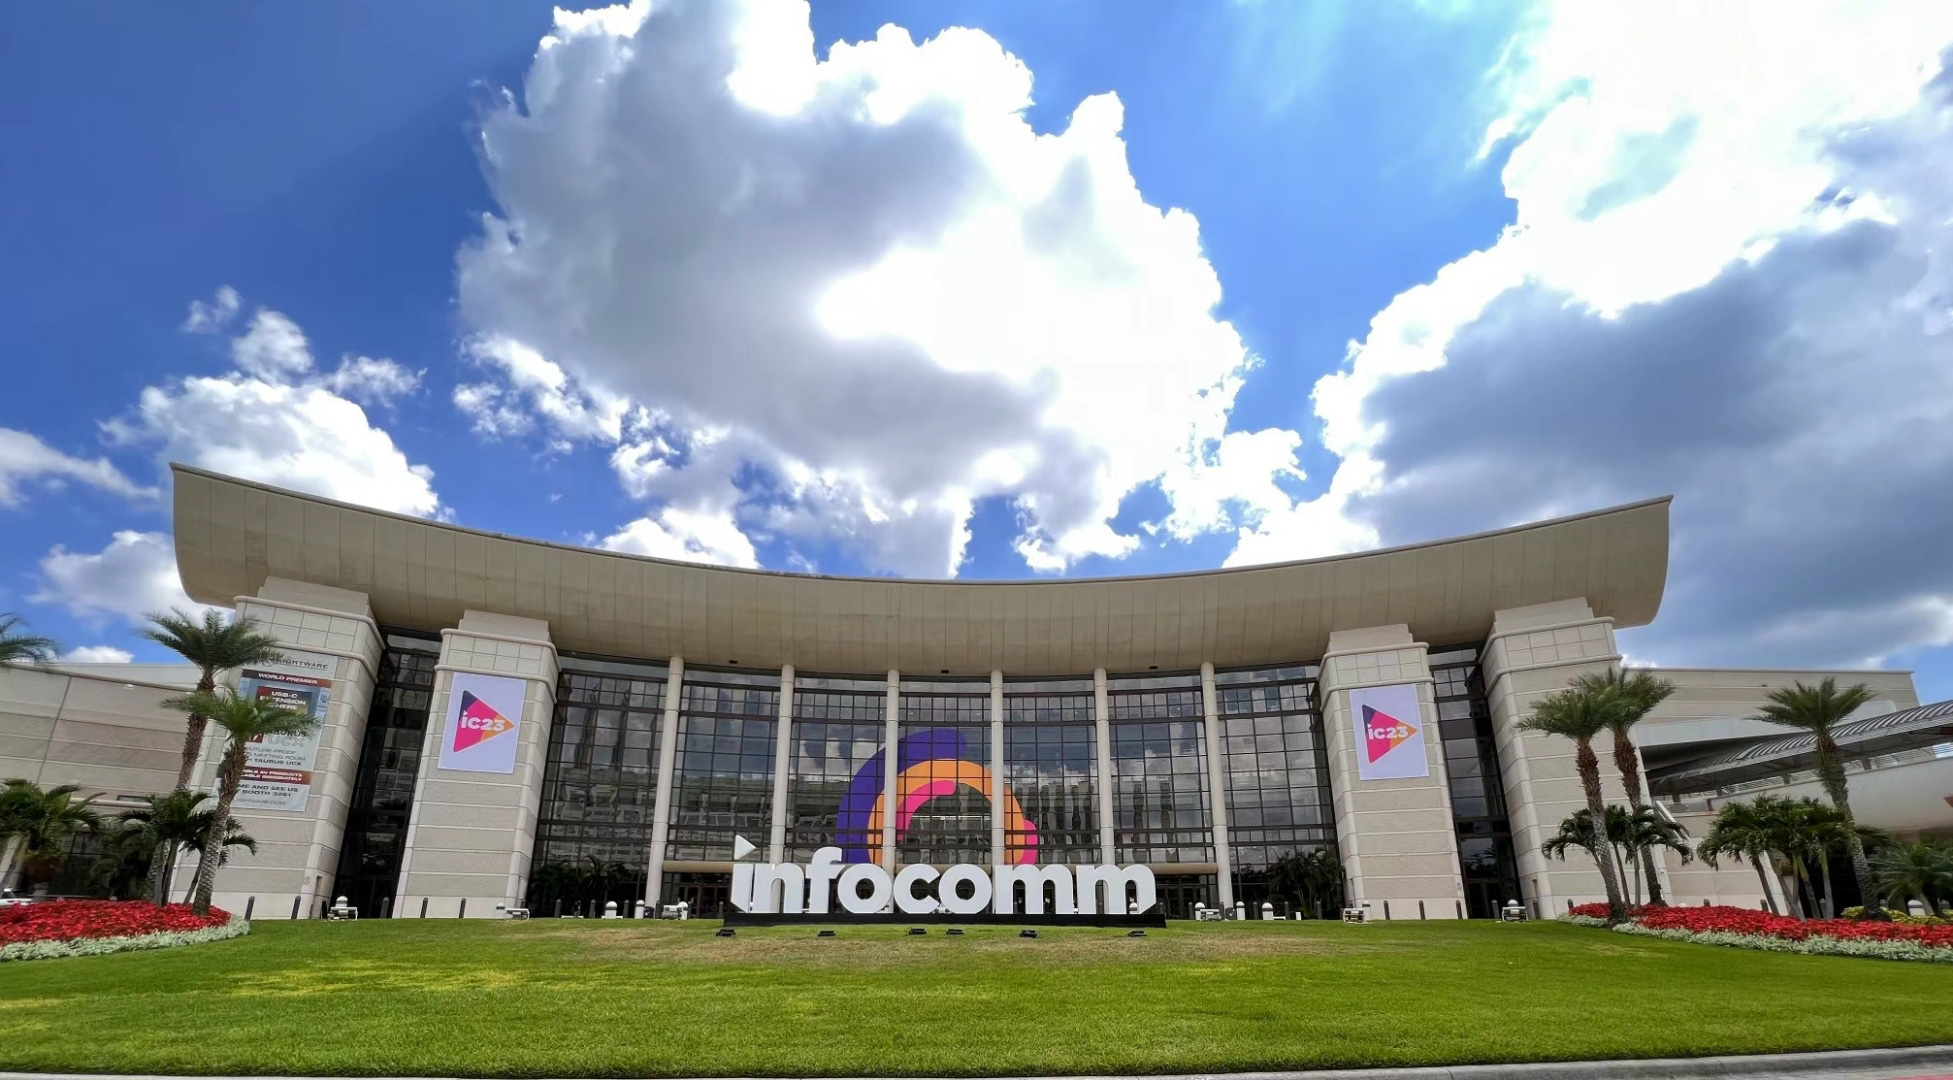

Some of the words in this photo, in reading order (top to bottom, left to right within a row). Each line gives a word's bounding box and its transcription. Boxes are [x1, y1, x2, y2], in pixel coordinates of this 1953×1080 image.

[286, 676, 318, 684] PREMIER
[259, 695, 306, 705] EENSION
[271, 691, 298, 699] USB-C
[461, 710, 505, 731] ic23
[1367, 723, 1409, 740] ic23
[268, 734, 305, 747] UCX
[730, 834, 1157, 915] infocomm
